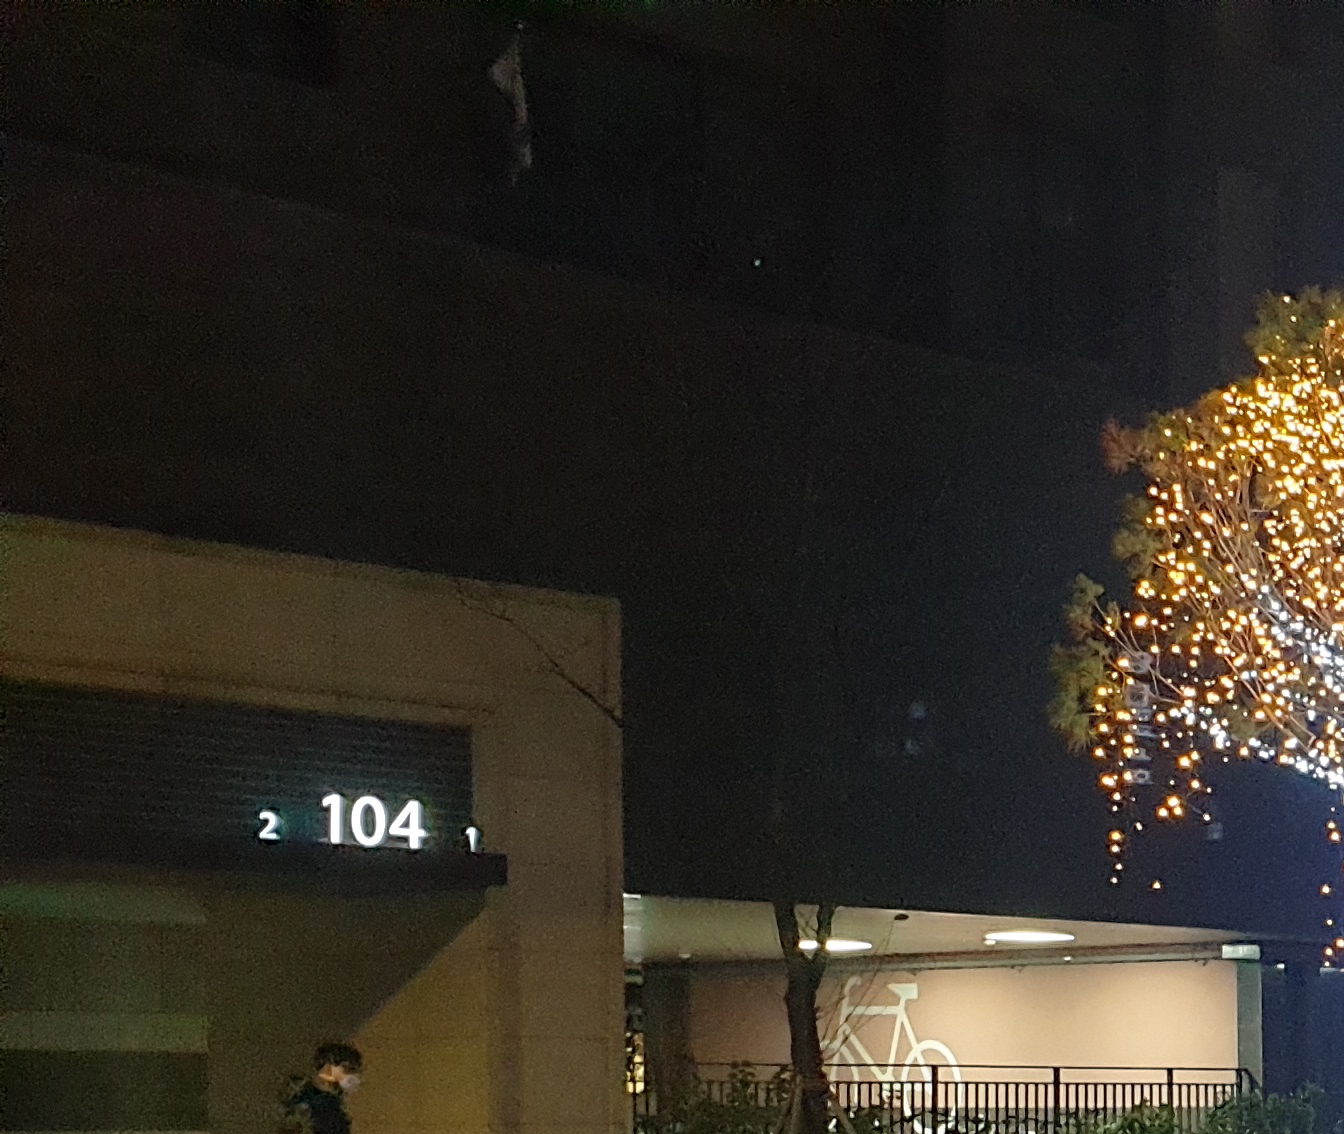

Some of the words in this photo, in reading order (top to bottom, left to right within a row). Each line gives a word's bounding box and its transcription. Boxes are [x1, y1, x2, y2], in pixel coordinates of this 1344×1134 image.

[258, 809, 281, 841] 2
[321, 792, 428, 850] 104
[464, 826, 481, 853] 1
